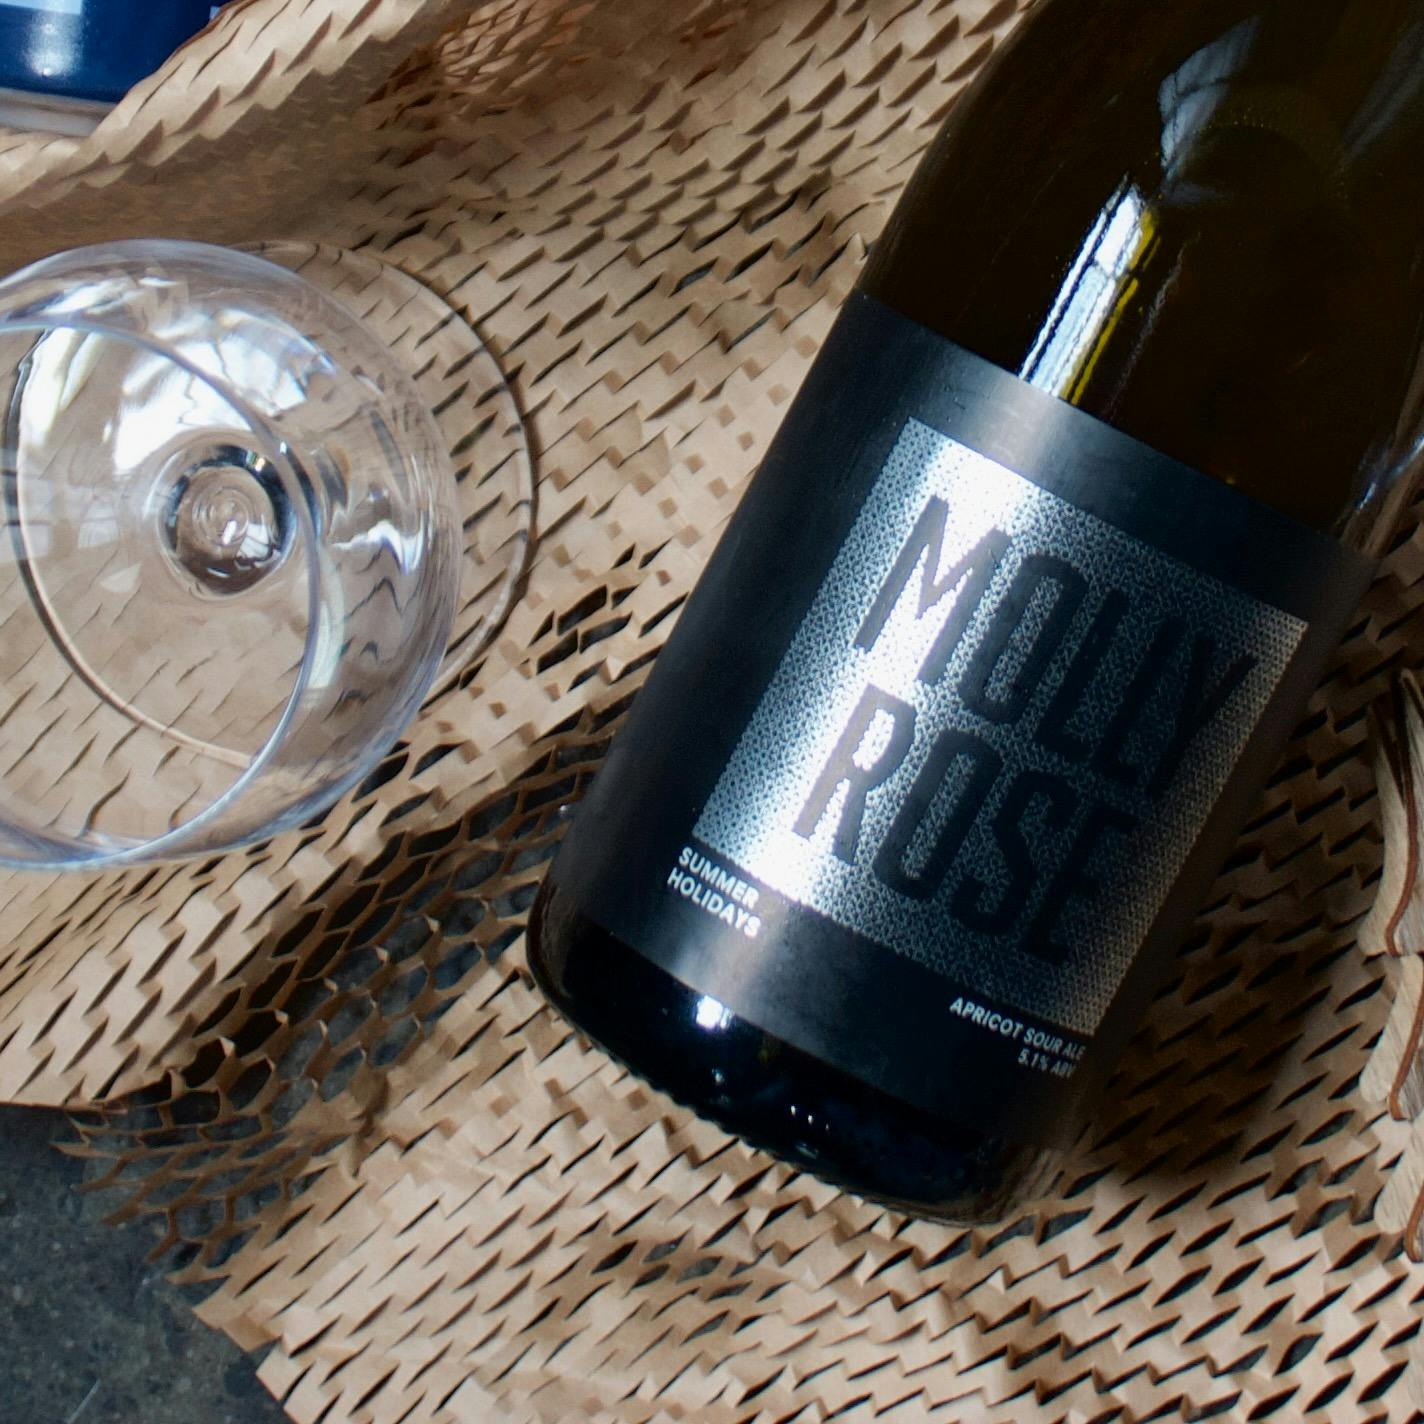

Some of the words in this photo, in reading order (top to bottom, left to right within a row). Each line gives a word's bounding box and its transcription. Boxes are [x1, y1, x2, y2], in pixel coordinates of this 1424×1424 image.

[855, 494, 1260, 798] MOLLY
[790, 682, 1143, 965] ROSE
[667, 867, 761, 938] HOLIDAYS
[678, 847, 759, 910] SUMMER
[949, 997, 1024, 1040] APRICOT
[1024, 1027, 1063, 1055] SOUR
